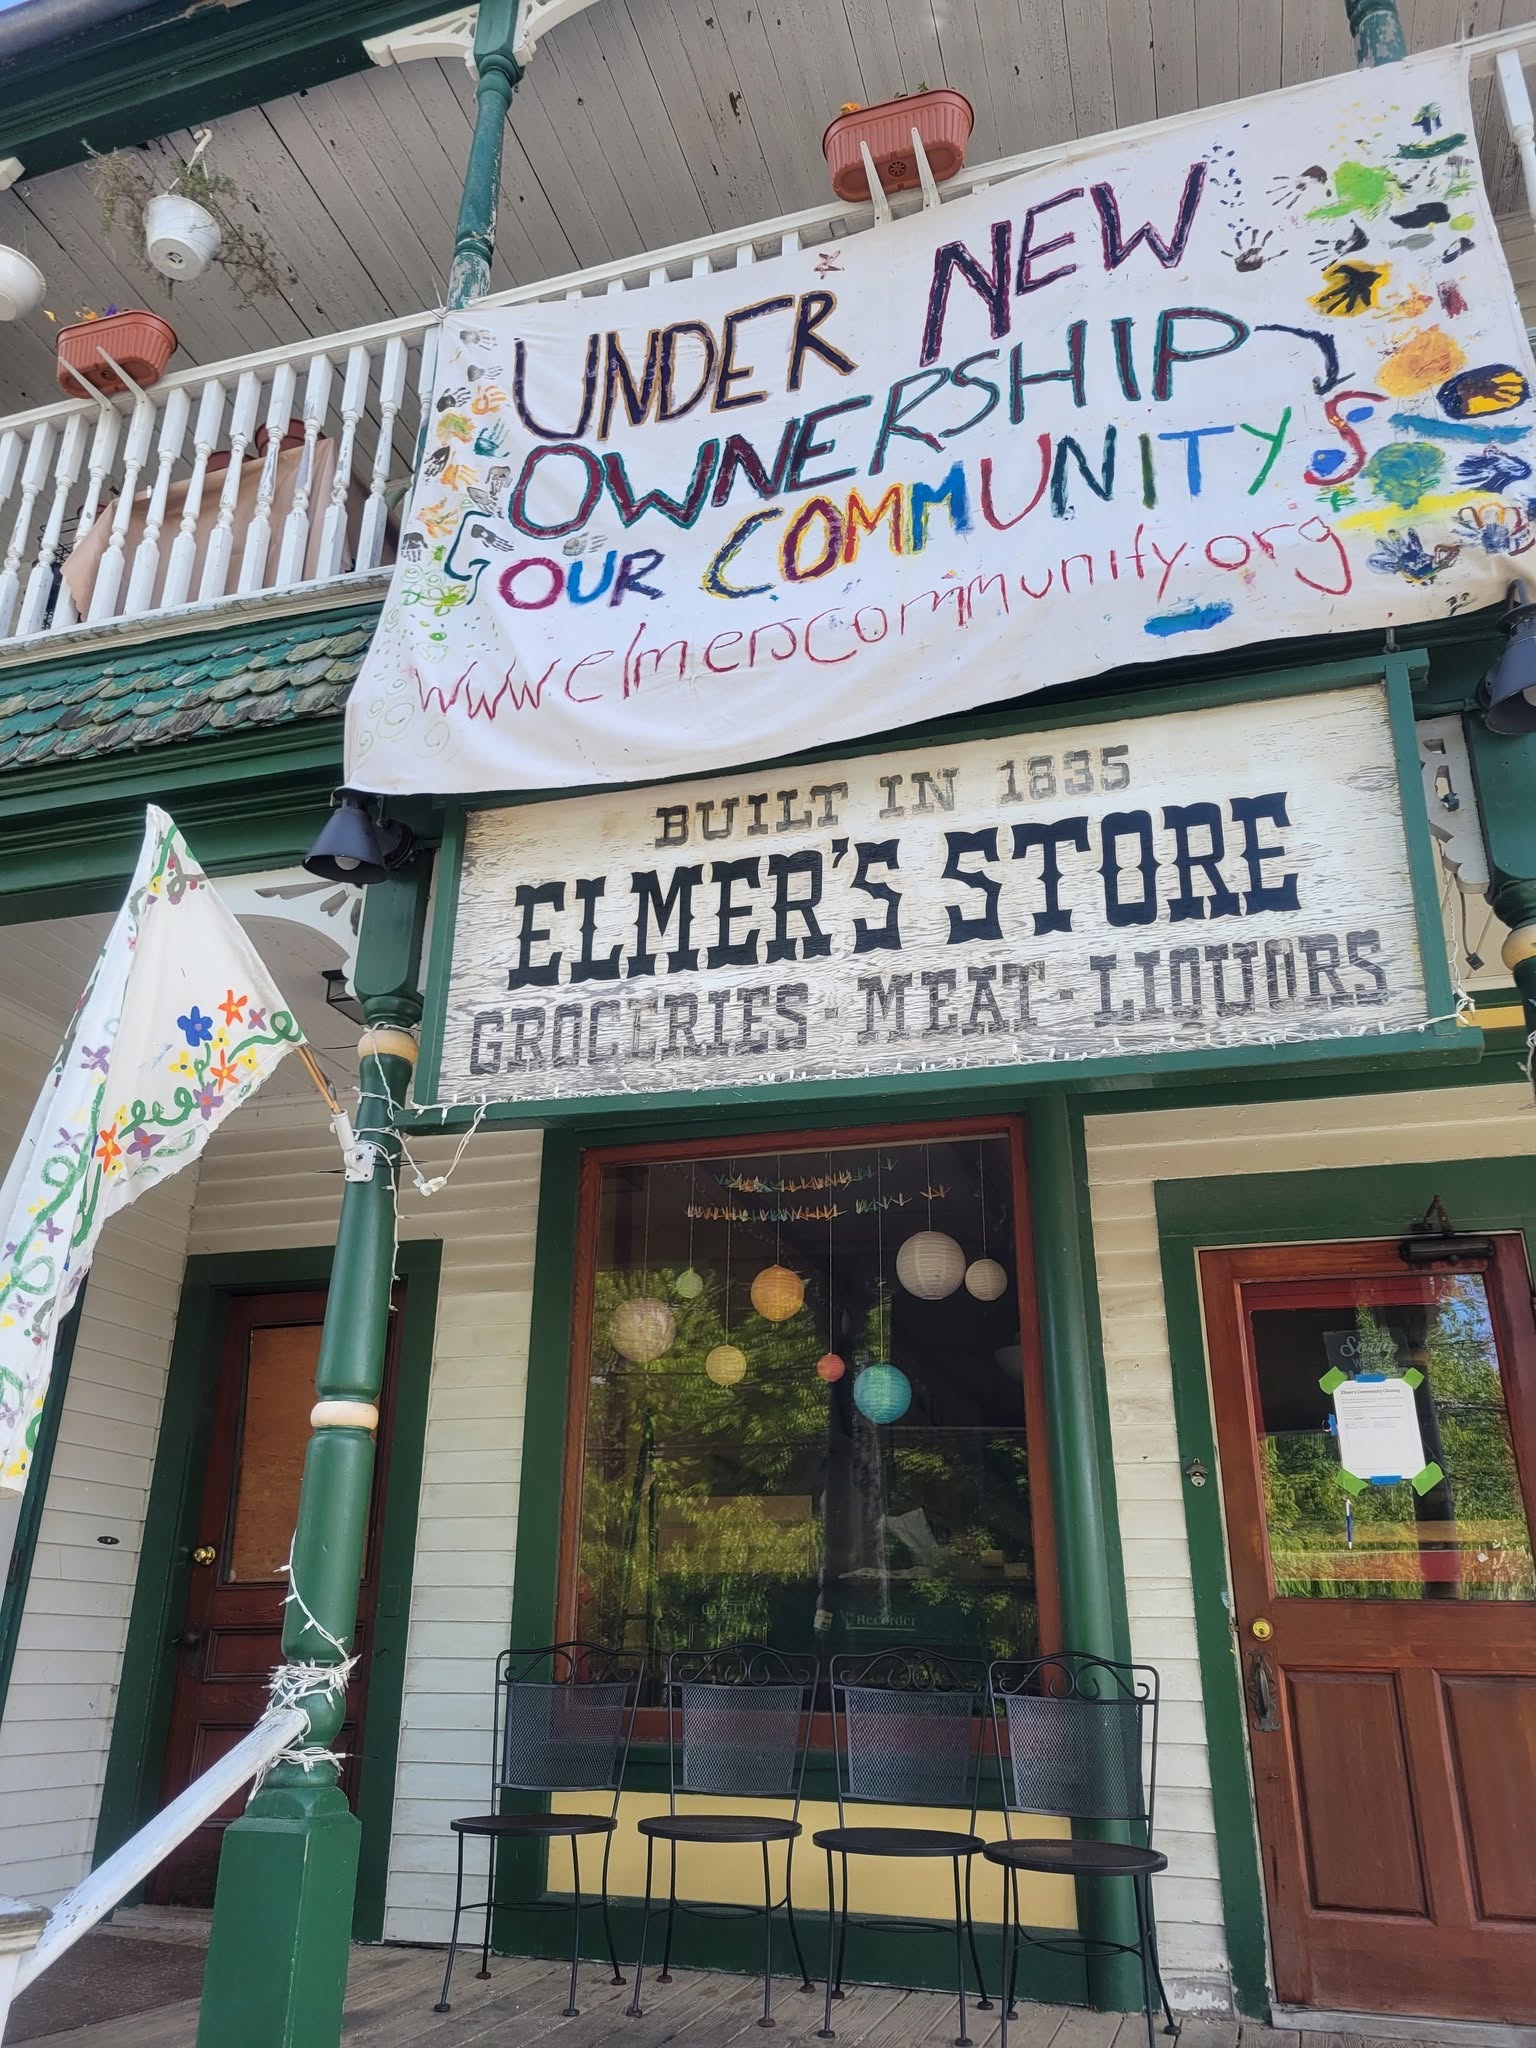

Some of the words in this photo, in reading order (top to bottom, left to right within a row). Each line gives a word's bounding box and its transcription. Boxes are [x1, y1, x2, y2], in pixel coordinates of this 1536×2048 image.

[513, 290, 858, 441] UNDER
[920, 163, 1208, 368] NEW
[508, 307, 1250, 541] OWNERSHIP
[498, 549, 665, 610] OUR
[655, 781, 849, 848] BUILT
[879, 766, 960, 820] IN
[1000, 744, 1130, 804] 1835
[507, 836, 903, 991] ELMER'S
[942, 791, 1301, 945] STORE
[857, 960, 1046, 1046] MEAT
